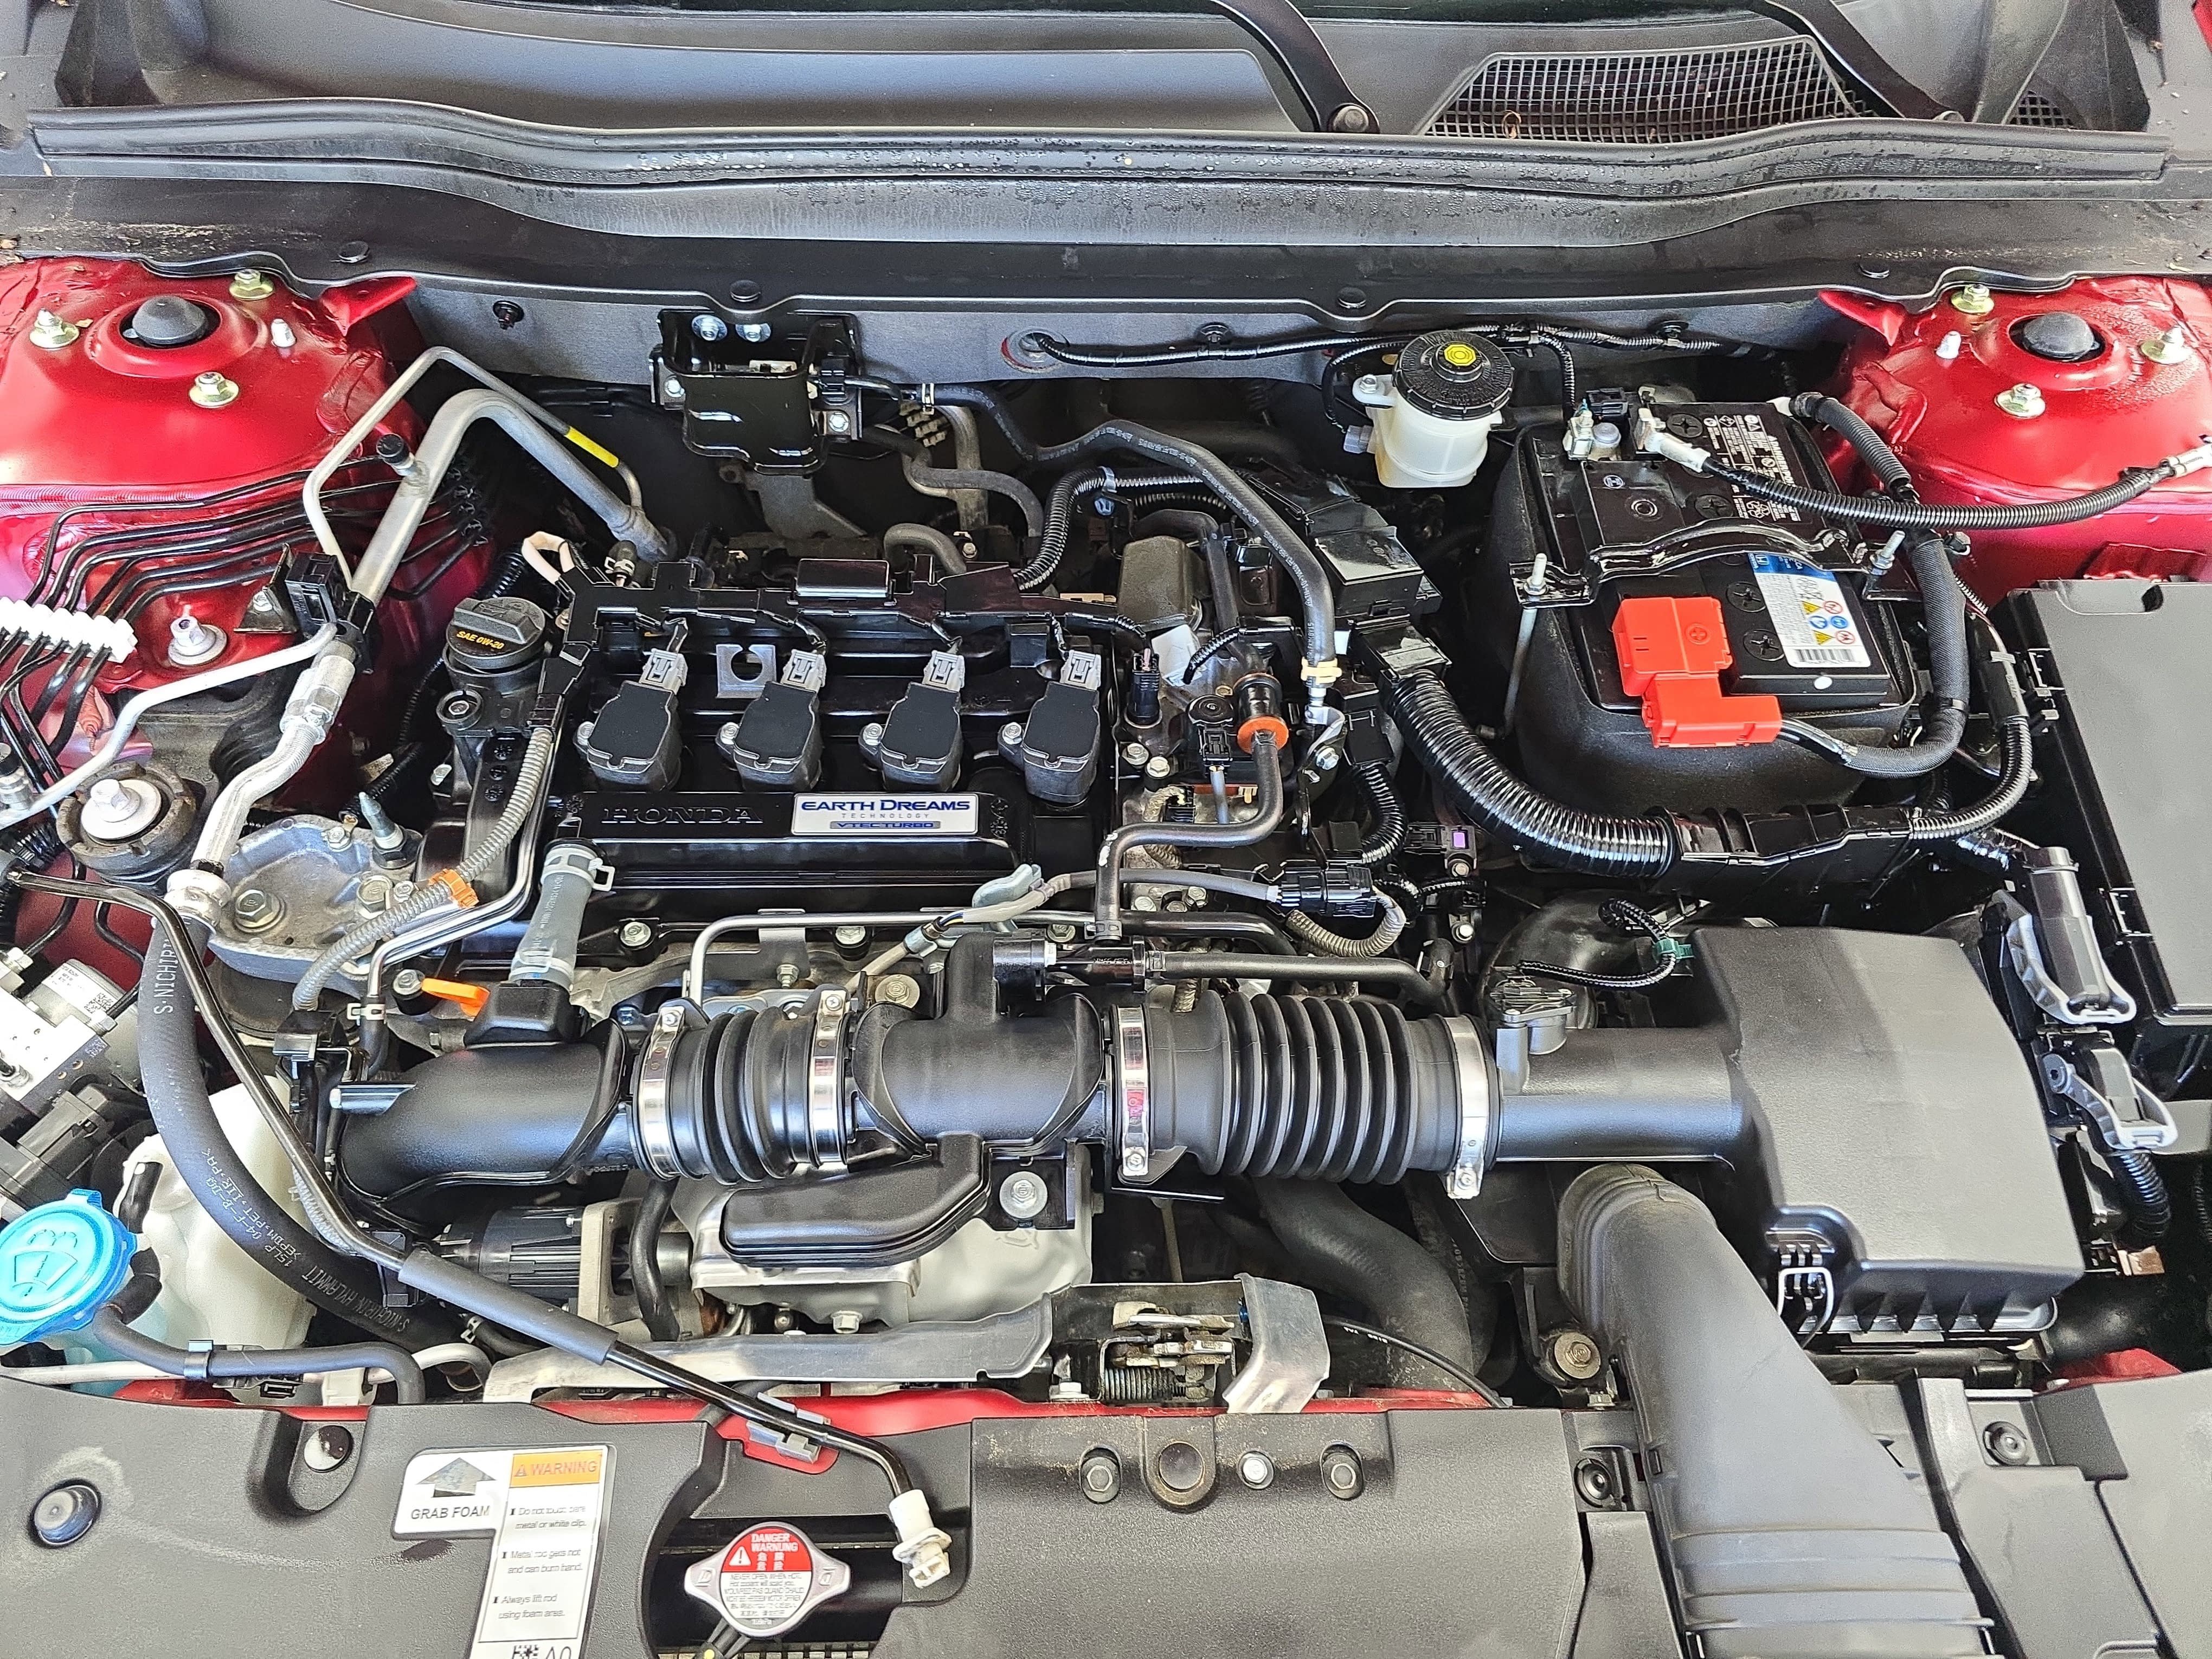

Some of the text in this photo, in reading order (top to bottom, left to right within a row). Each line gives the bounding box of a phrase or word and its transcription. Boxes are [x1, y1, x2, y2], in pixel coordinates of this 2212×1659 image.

[1771, 441, 1797, 486] DANGER/POI
[456, 631, 505, 650] SAE 0W-20
[801, 799, 970, 811] EARTH DREAMS
[601, 807, 763, 824] HONDA
[153, 938, 178, 1015] S·NICHIRI
[531, 1460, 599, 1476] WARNING
[410, 1504, 491, 1520] GRAB FOAM
[751, 1533, 790, 1542] DANGER
[507, 1565, 524, 1574] and
[541, 1564, 561, 1572] burn
[500, 1593, 558, 1604] Always lift rod
[498, 1611, 521, 1620] using
